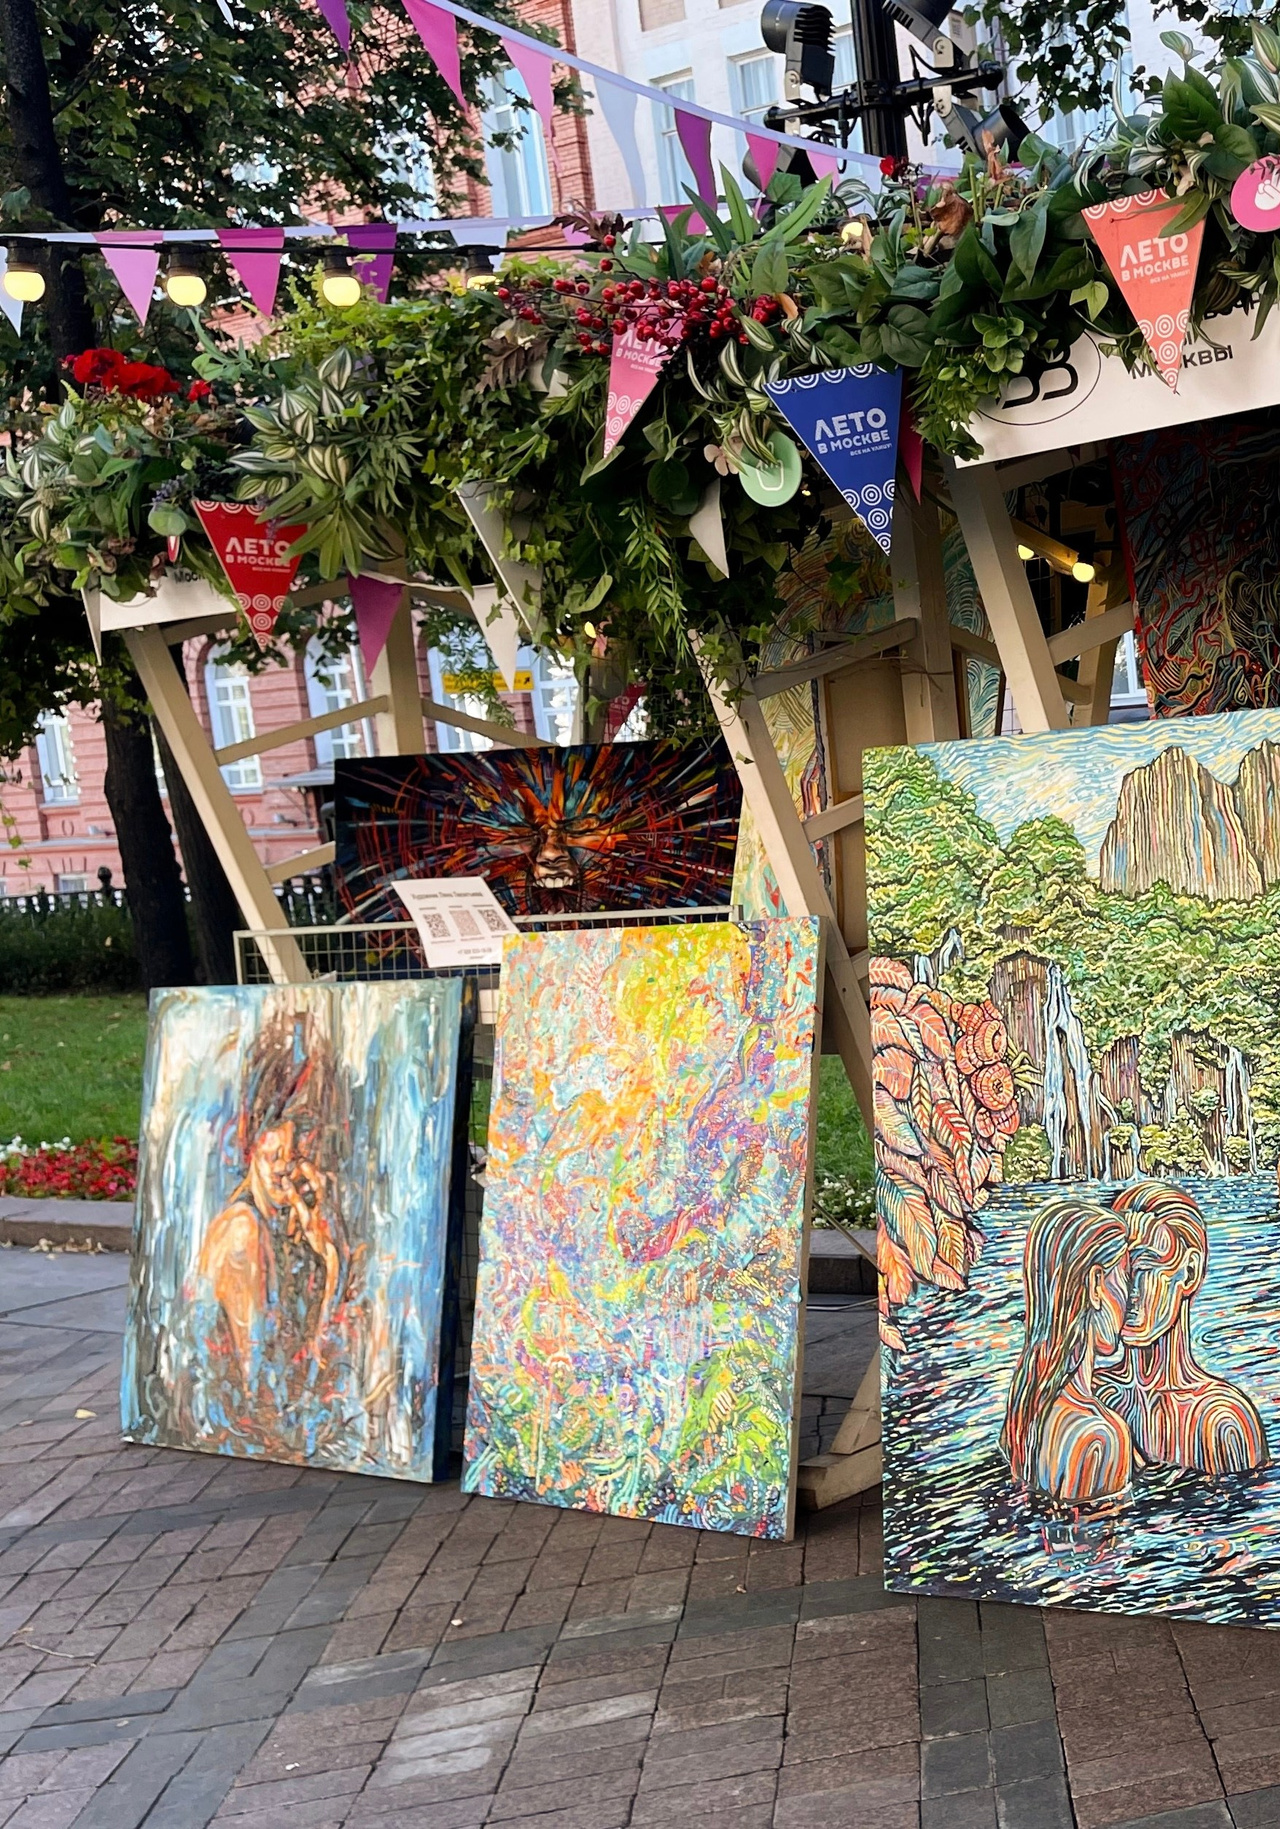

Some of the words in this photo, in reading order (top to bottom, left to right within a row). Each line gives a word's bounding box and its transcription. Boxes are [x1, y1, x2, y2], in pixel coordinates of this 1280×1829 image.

[1120, 232, 1189, 268] ЛЕТО
[1121, 270, 1131, 282] В
[1133, 254, 1189, 279] МОСКВЕ
[615, 347, 623, 358] В
[624, 350, 662, 368] МОСКВЕ
[814, 407, 887, 441] ЛЕТО
[817, 442, 828, 455] В
[830, 429, 890, 452] МОСКВЕ
[225, 536, 291, 557] ЛЕТО
[225, 553, 235, 564] В
